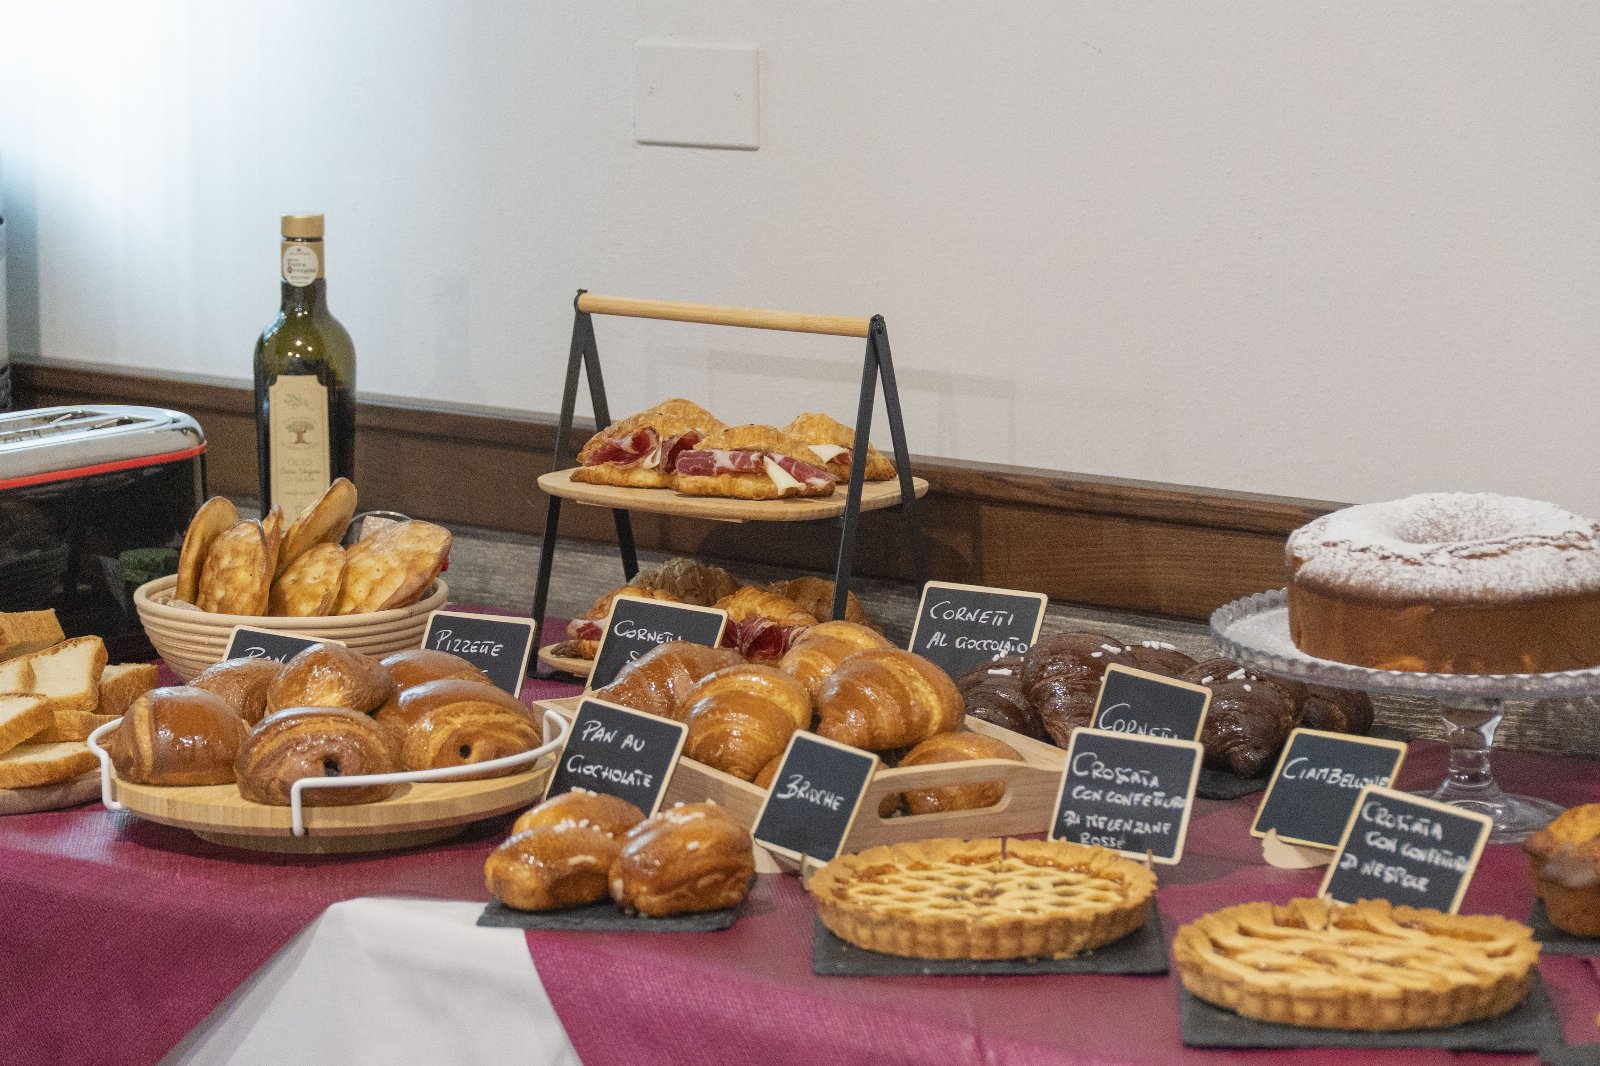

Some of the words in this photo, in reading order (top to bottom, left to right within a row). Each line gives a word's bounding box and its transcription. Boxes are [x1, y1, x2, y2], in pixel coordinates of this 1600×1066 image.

[929, 600, 1014, 626] CORNETTI
[435, 629, 504, 656] PIZZETTE
[926, 631, 947, 649] AL
[582, 720, 618, 742] PAN
[620, 733, 645, 752] AU
[776, 773, 844, 811] BRIOCHE
[1071, 785, 1102, 801] CON
[1365, 831, 1398, 853] CON
